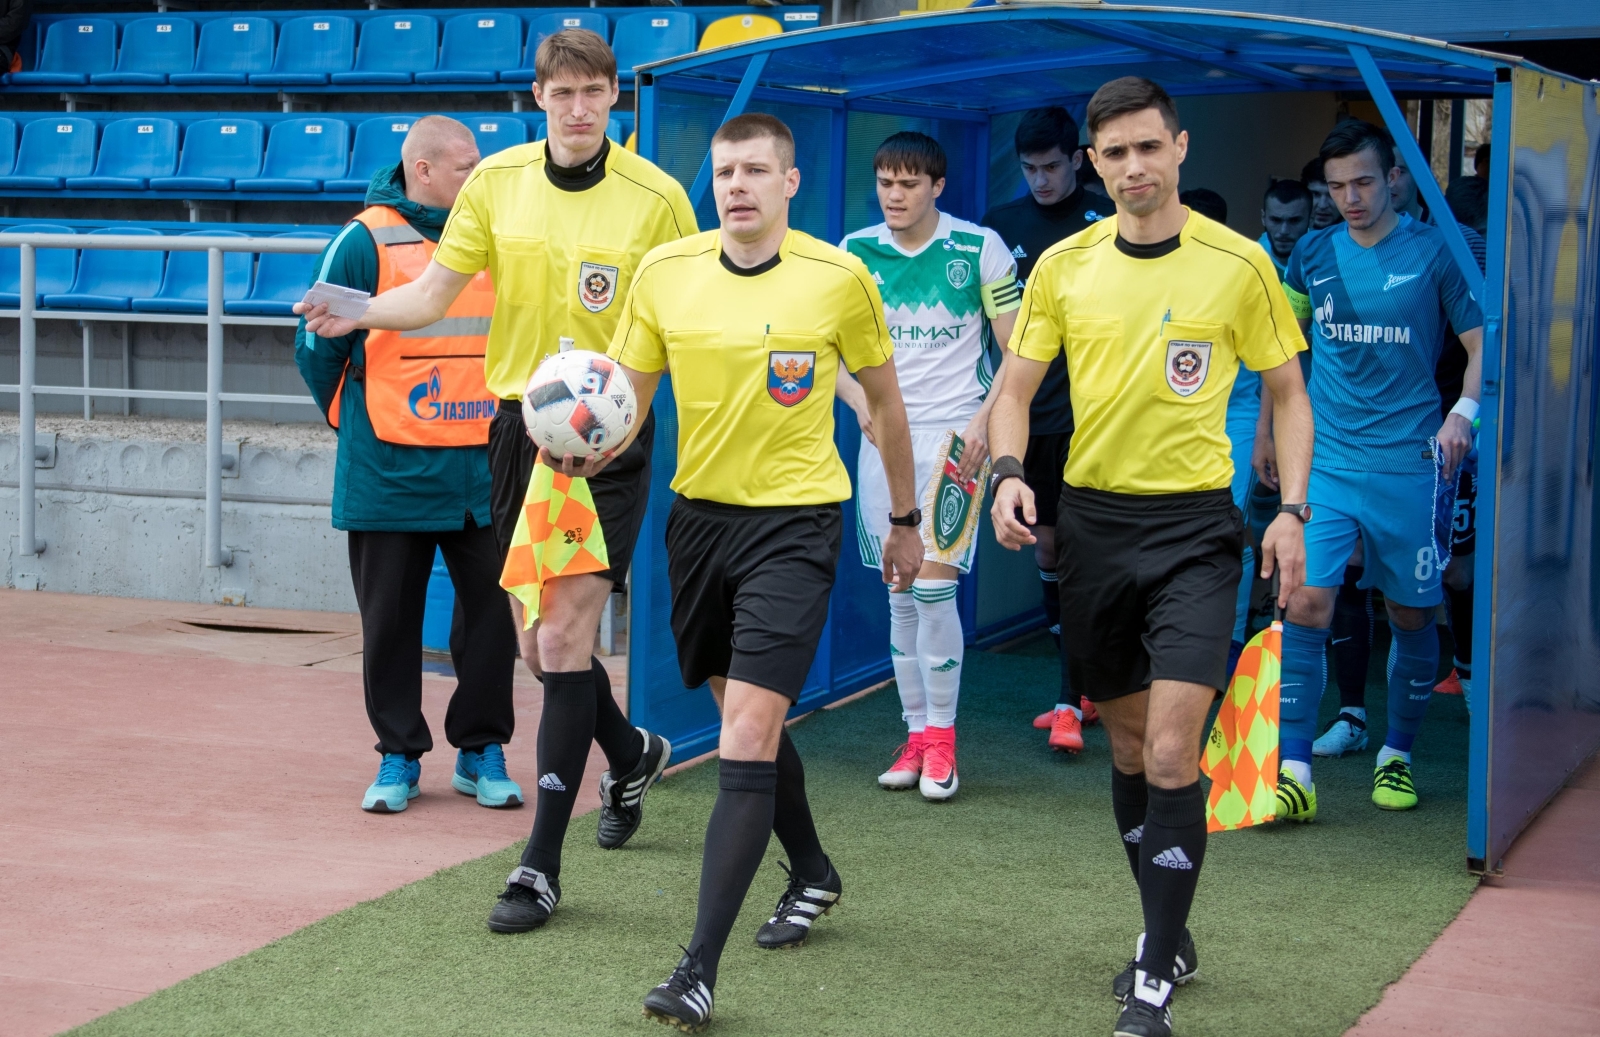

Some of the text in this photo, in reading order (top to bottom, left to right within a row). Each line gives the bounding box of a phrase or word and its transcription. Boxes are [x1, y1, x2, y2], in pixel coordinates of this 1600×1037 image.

[887, 323, 967, 340] KHMAT
[1337, 323, 1410, 344] ГАЗПРОМ
[443, 399, 496, 420] ГАЗПРОМ
[1415, 546, 1441, 580] 8
[539, 780, 566, 791] adidas
[1123, 834, 1142, 843] adi
[1152, 857, 1193, 870] adidas
